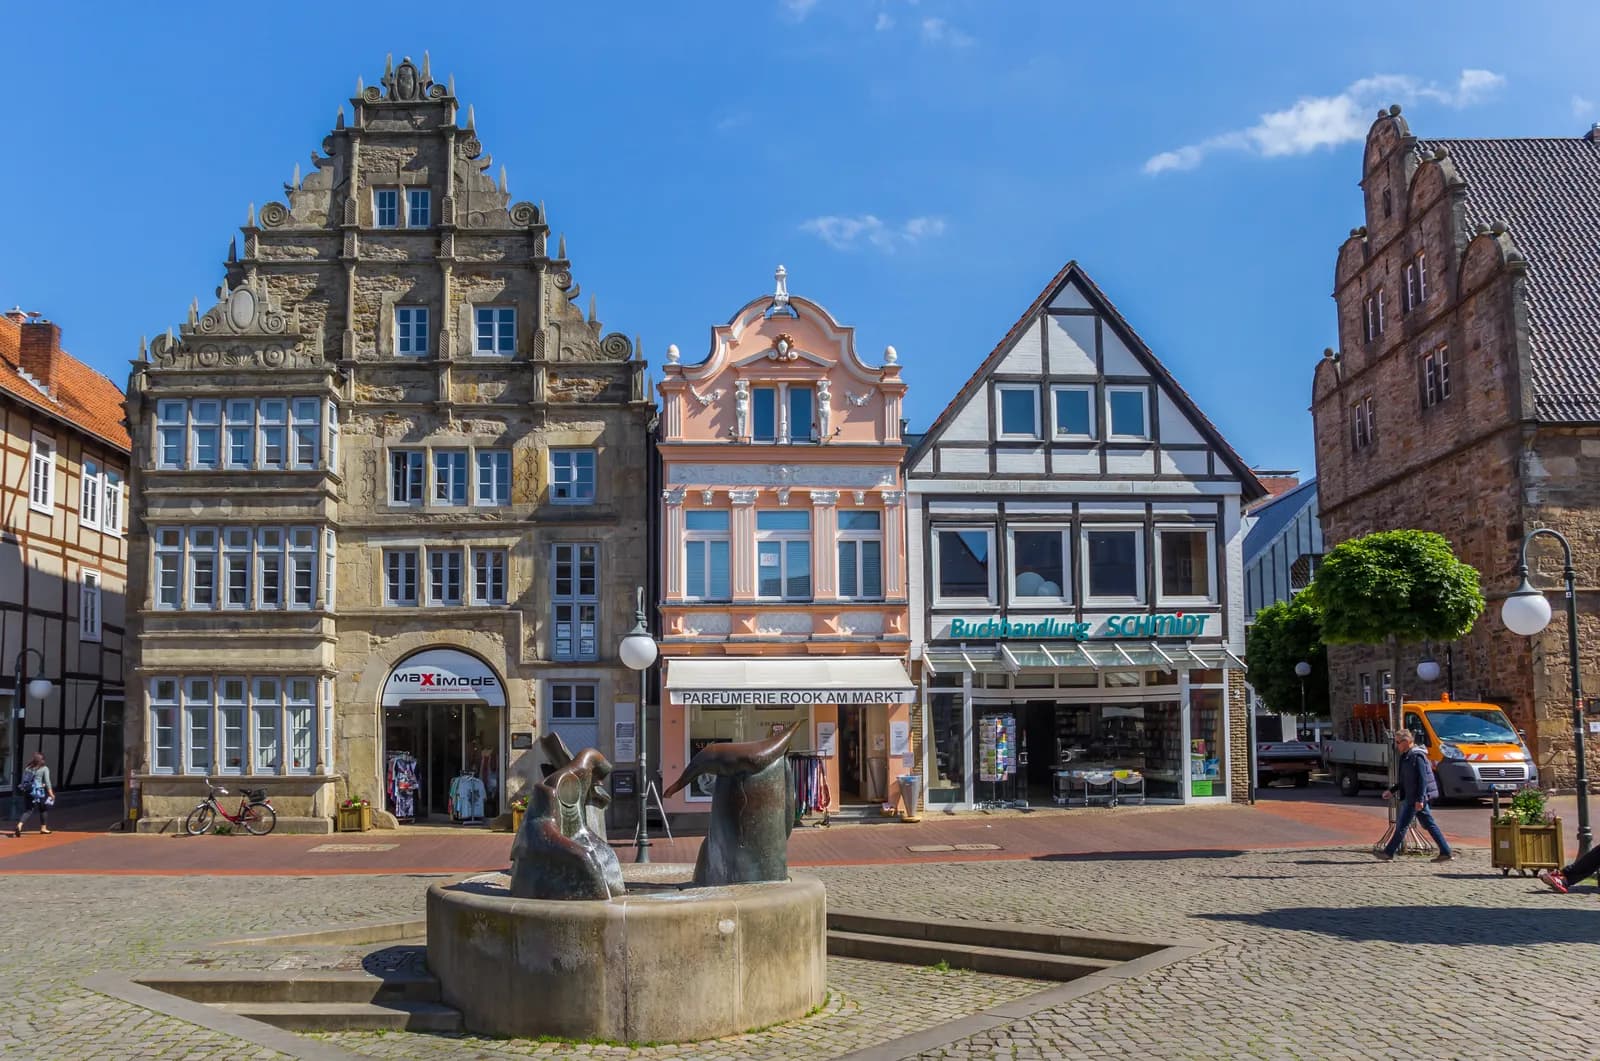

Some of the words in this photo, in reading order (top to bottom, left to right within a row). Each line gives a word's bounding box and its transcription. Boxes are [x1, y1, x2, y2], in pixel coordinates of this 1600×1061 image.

[950, 617, 1091, 641] Buchhandlung
[682, 690, 776, 704] PARFÜMERIE
[781, 691, 822, 704] ROOK
[826, 691, 848, 704] AM
[853, 691, 904, 704] MARKT
